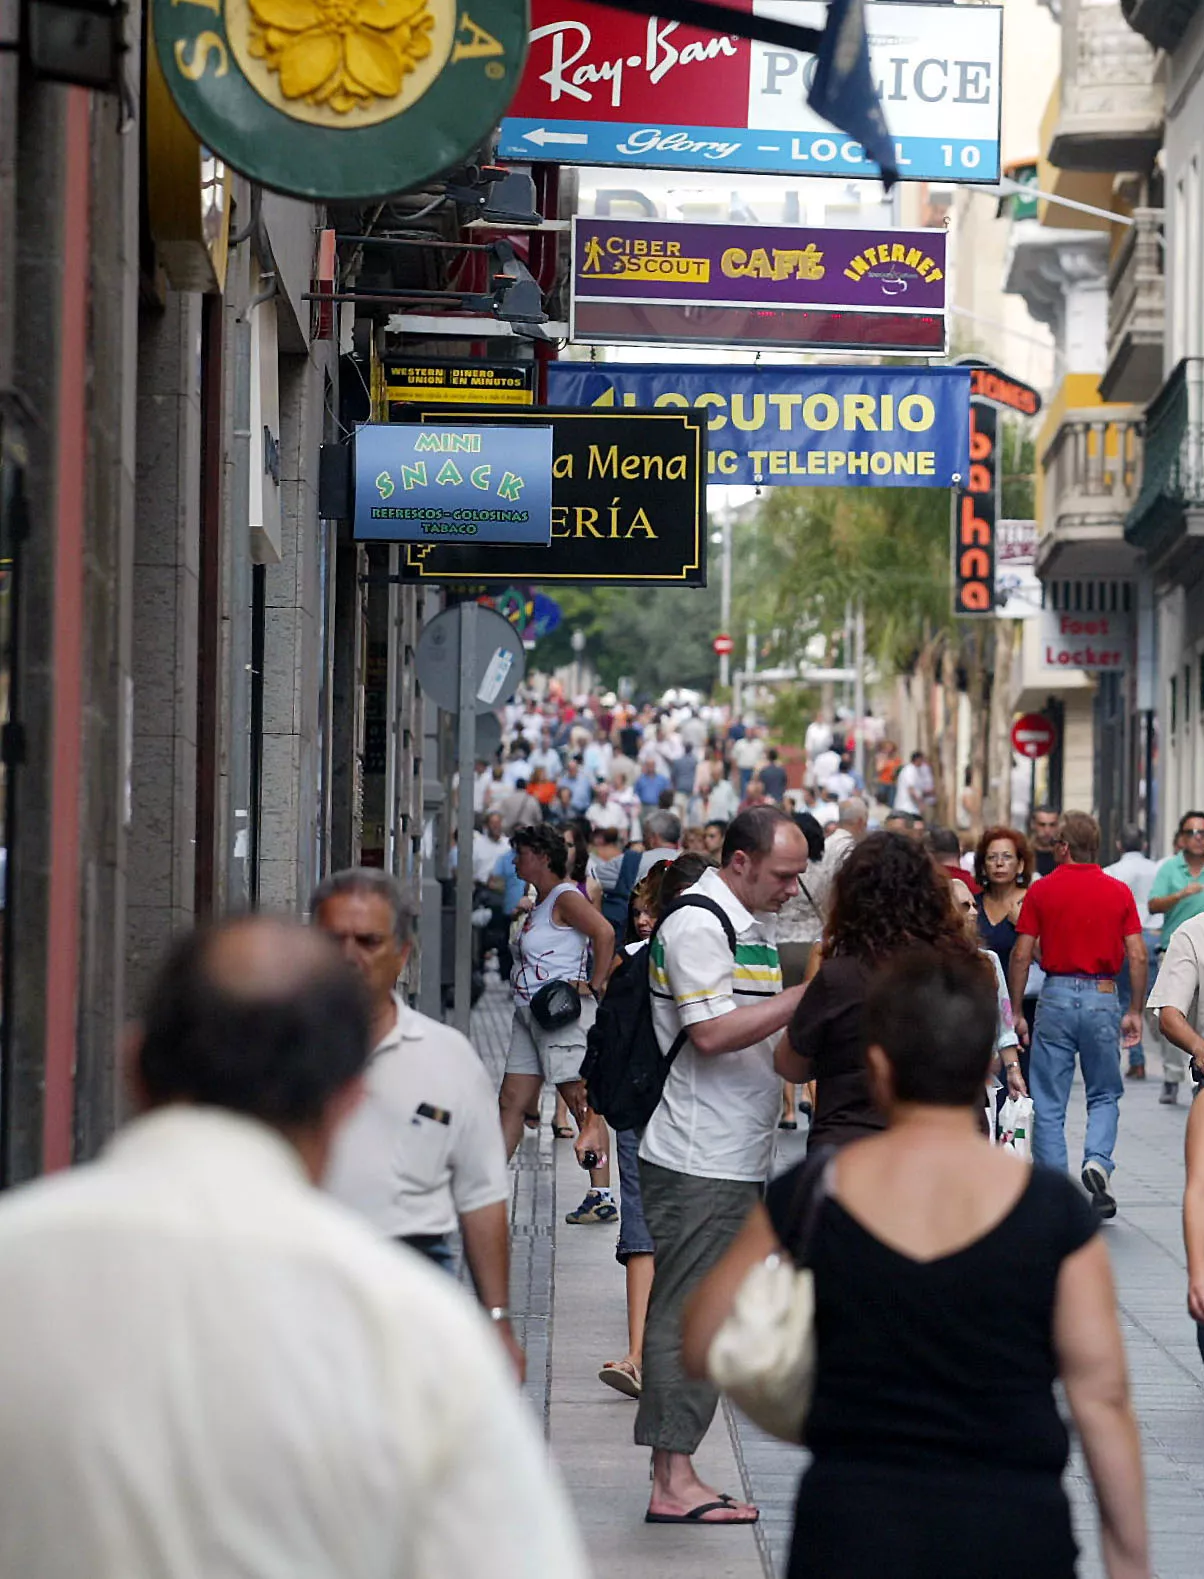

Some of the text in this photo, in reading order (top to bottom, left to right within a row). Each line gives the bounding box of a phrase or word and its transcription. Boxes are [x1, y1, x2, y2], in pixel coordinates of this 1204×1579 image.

[761, 51, 991, 104] PICE
[616, 129, 742, 159] Glory
[791, 138, 911, 166] LOCL
[941, 144, 981, 168] 10
[605, 236, 681, 256] CIBER
[629, 258, 704, 277] SCOUT
[720, 243, 826, 281] CAFÉ
[843, 243, 944, 283] INTERNET
[391, 368, 444, 376] WESTERN
[452, 369, 494, 377] DINERO
[471, 378, 521, 386] MINUTOS
[413, 432, 481, 453] MINI
[588, 444, 687, 480] Mena
[748, 451, 936, 475] TELEPHONE
[376, 459, 524, 502] SNACK
[422, 522, 478, 534] TABACO
[1061, 615, 1109, 635] Foot
[1046, 646, 1121, 664] Locker
